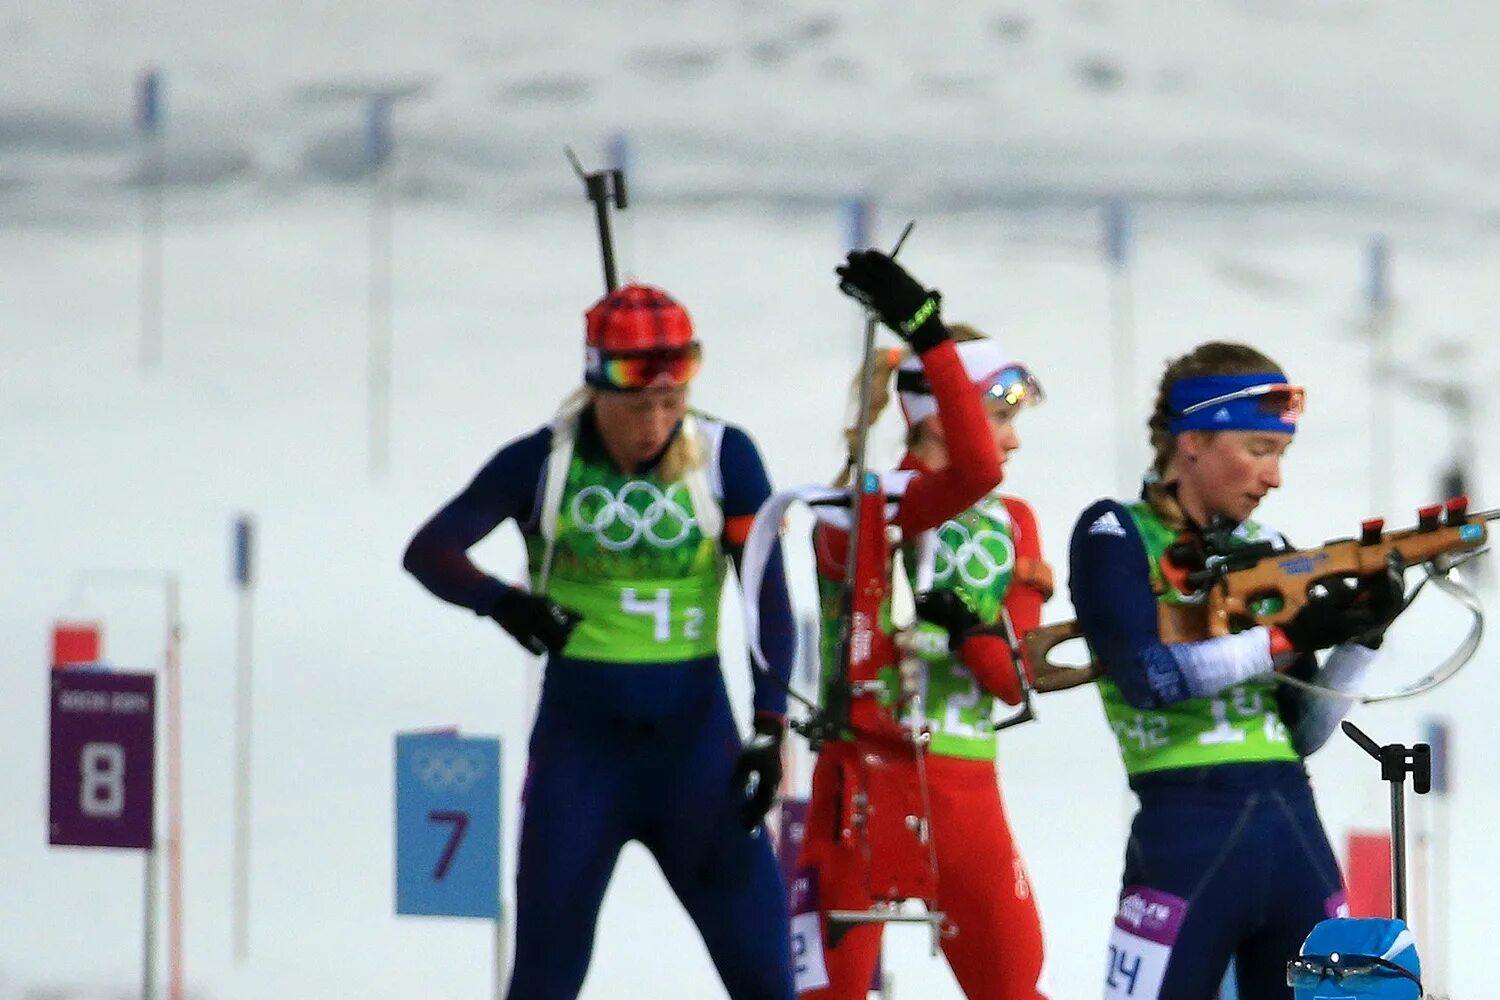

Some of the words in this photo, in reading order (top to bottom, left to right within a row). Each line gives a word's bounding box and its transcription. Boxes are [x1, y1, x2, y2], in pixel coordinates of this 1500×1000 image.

[621, 587, 671, 642] 4
[682, 606, 705, 640] 2
[79, 741, 126, 818] 8
[427, 810, 470, 881] 7
